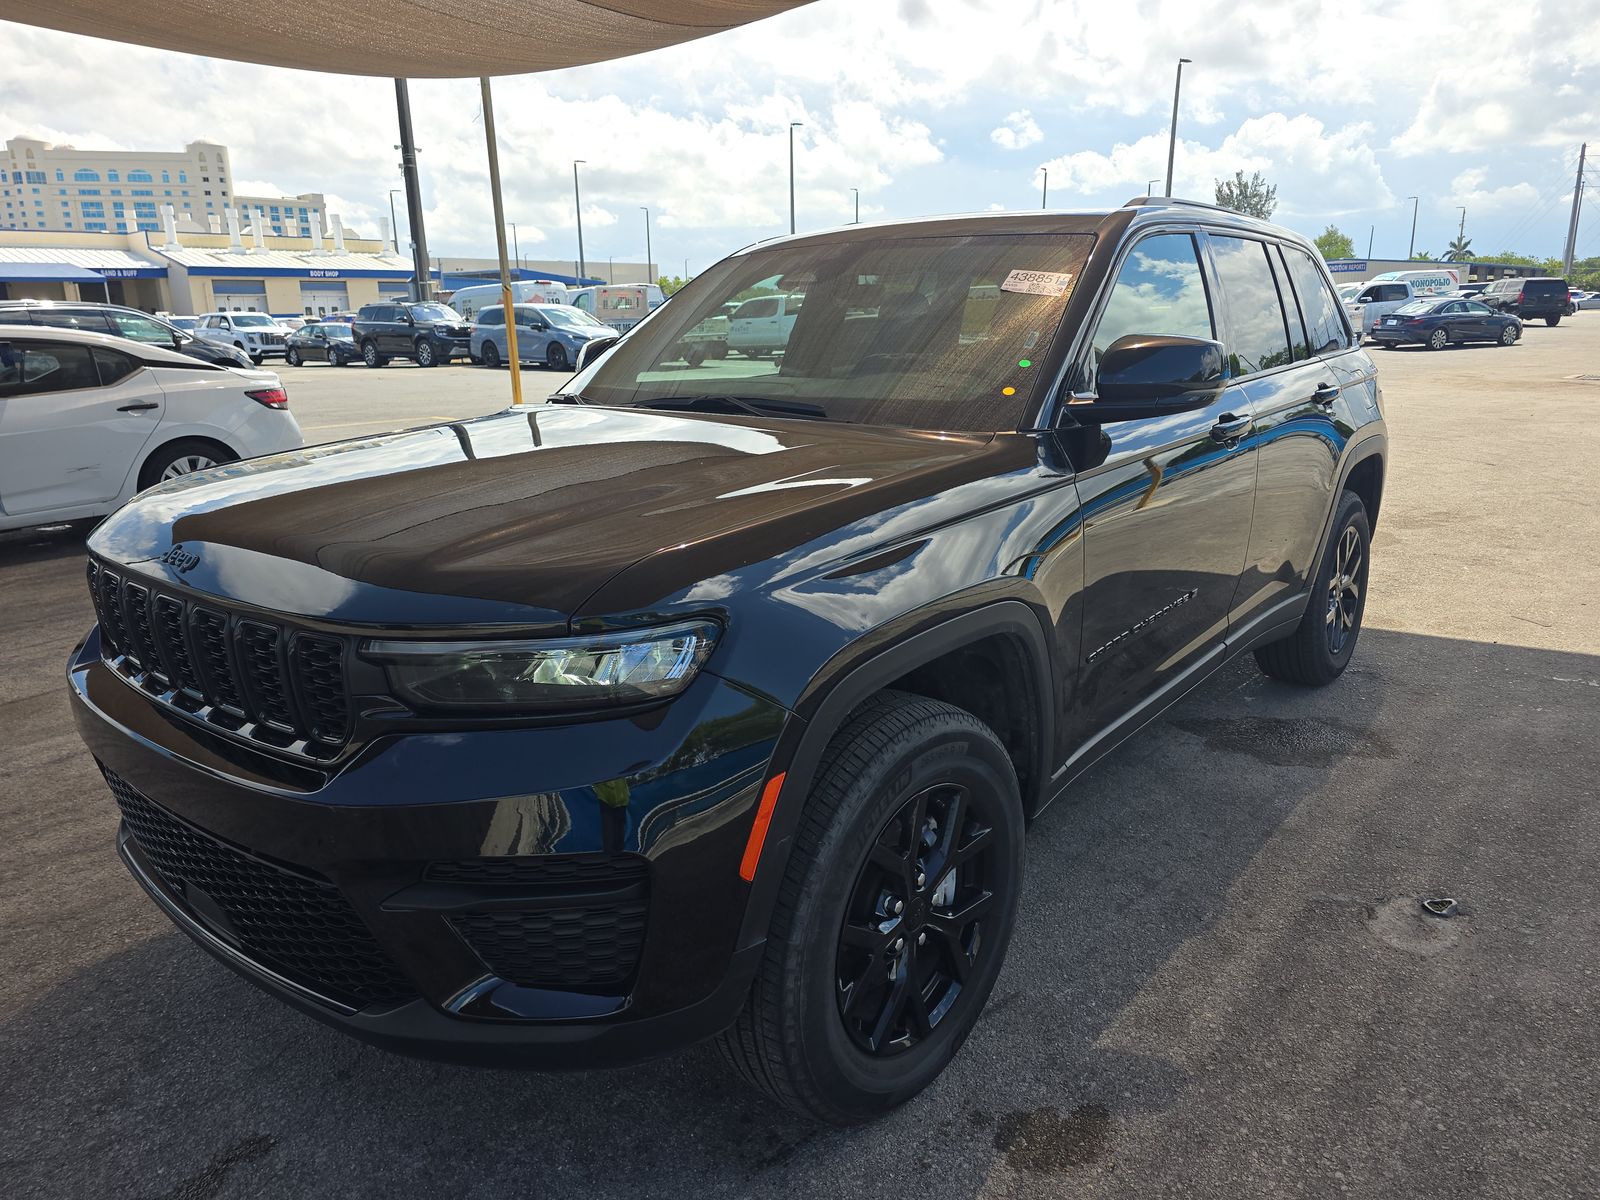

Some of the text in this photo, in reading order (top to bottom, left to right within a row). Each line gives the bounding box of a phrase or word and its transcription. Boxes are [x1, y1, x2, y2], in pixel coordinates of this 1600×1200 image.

[123, 269, 137, 277] BUFF
[161, 543, 200, 573] Jeep
[1131, 592, 1191, 634] CHEROKEE
